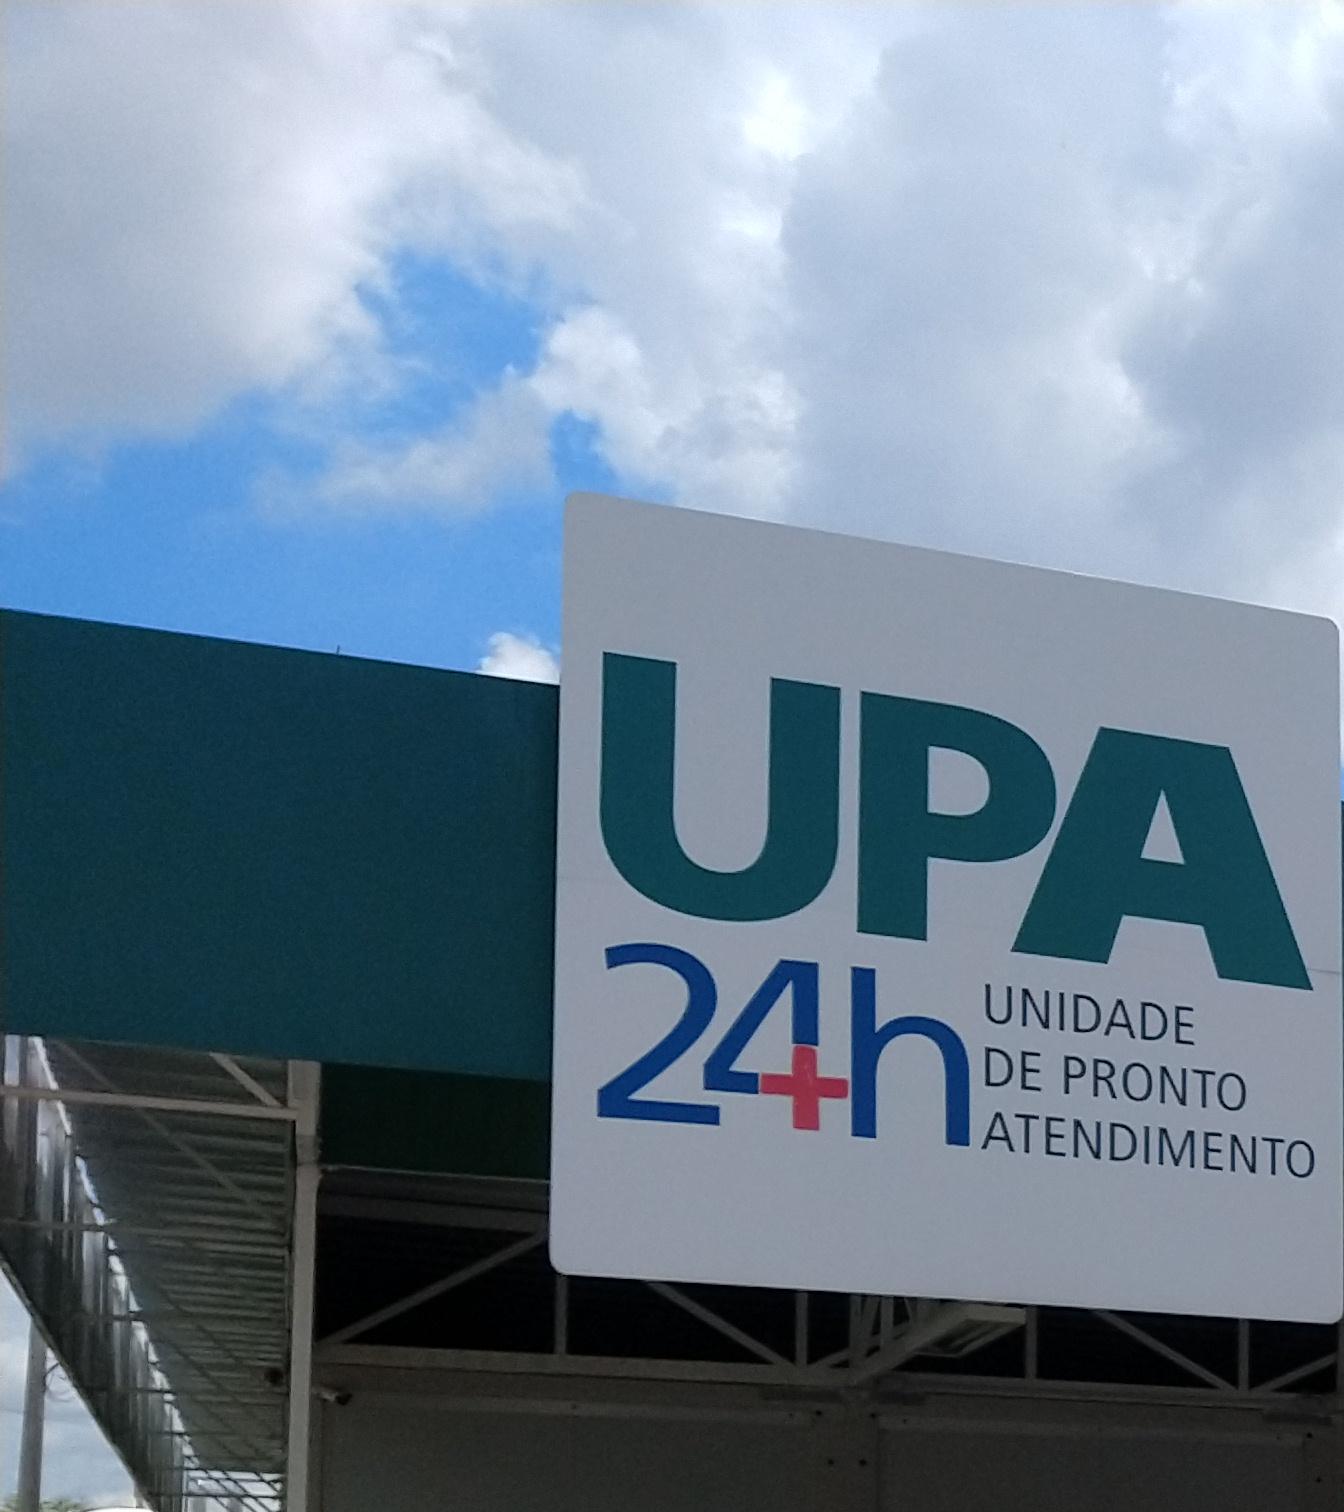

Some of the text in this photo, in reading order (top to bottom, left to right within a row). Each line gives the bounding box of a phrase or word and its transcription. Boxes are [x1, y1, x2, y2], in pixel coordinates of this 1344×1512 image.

[600, 652, 1314, 991] UPA
[597, 942, 970, 1147] 24h
[985, 984, 1196, 1046] UNIDADE
[984, 1046, 1247, 1111] DE PRONTO
[982, 1112, 1316, 1179] ATENDIMENTO
